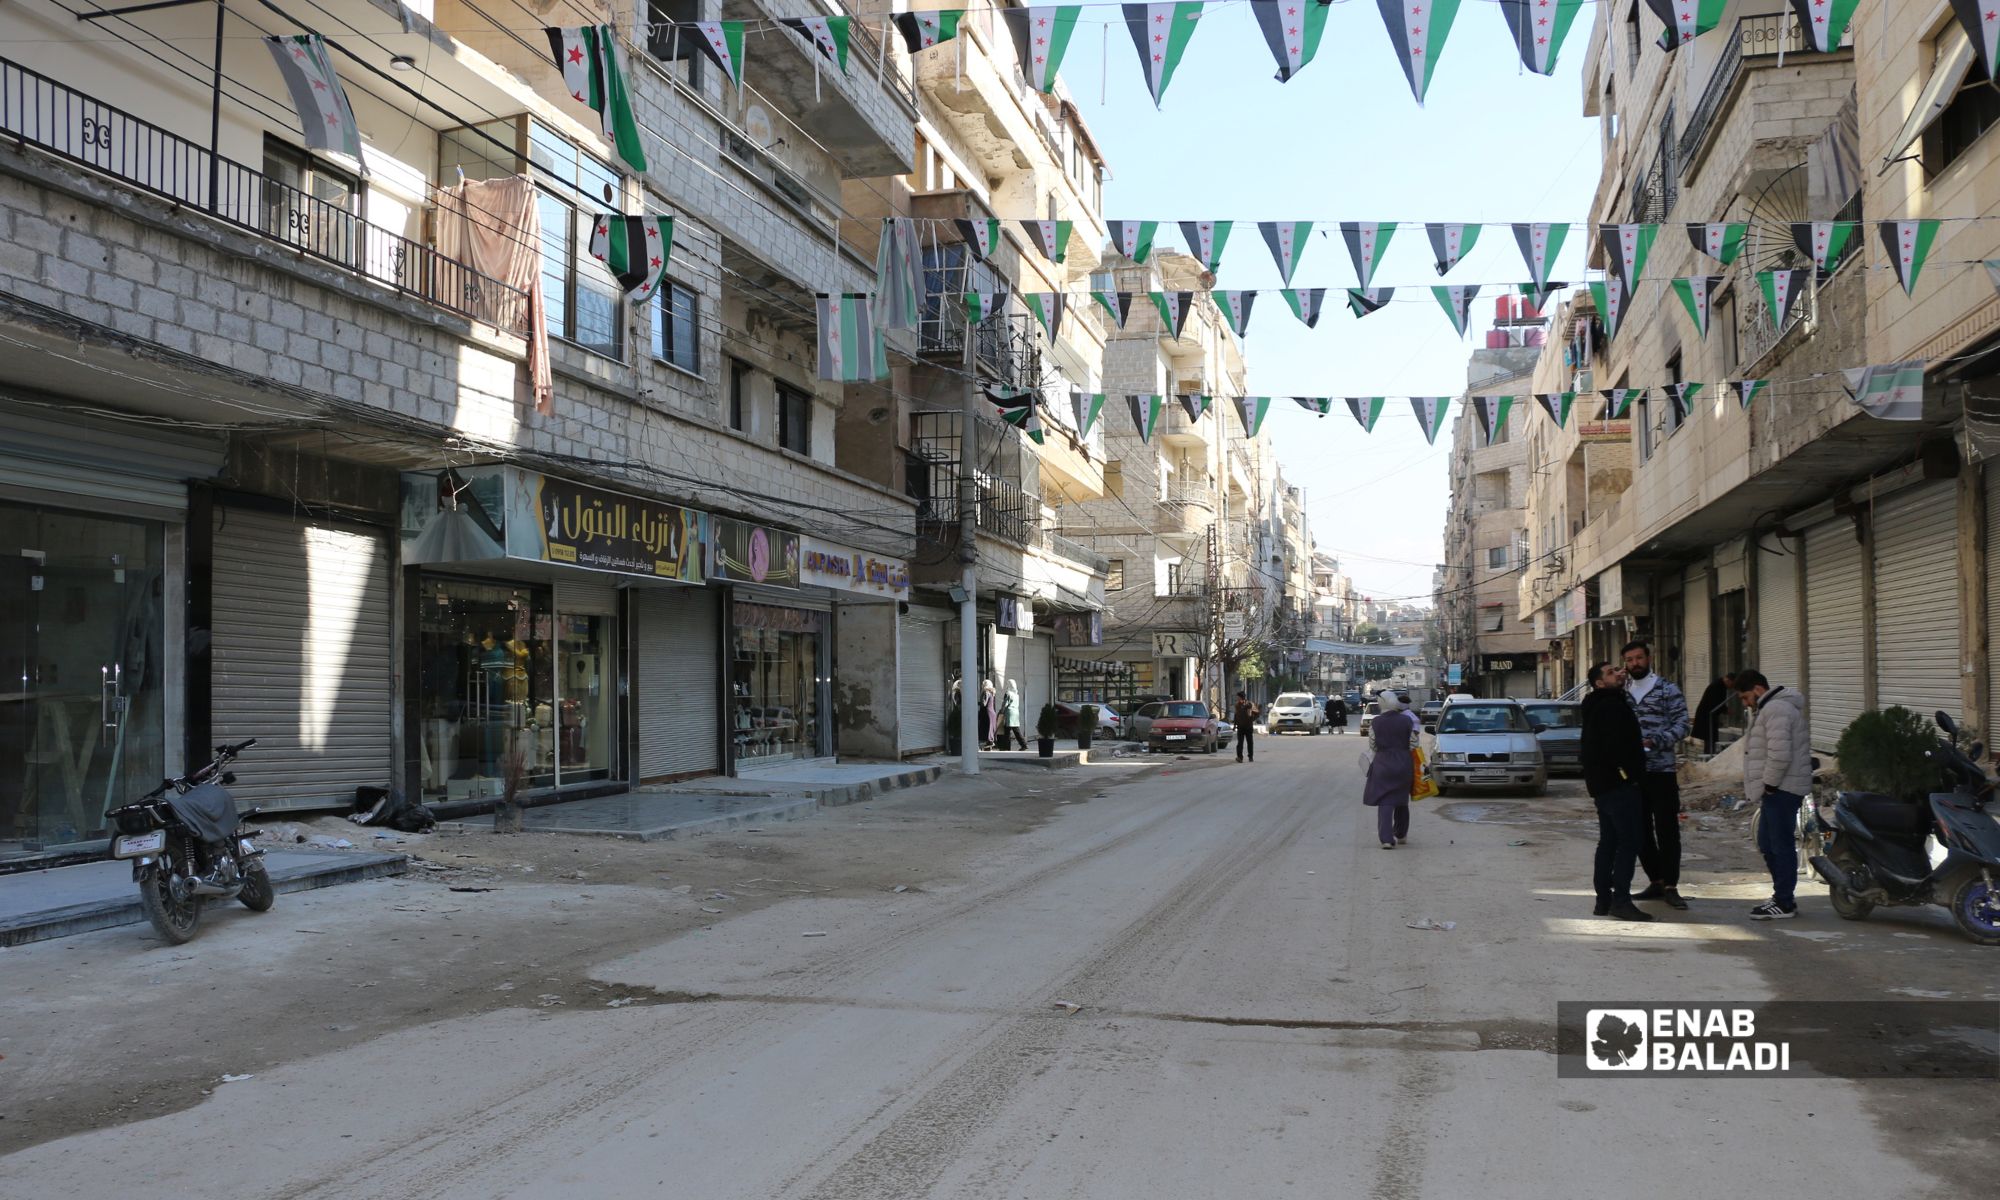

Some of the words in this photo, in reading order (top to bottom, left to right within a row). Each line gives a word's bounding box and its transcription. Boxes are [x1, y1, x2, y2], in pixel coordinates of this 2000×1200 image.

[563, 494, 627, 546] البتول
[632, 512, 669, 554] أزياء
[1490, 660, 1513, 670] BRAND
